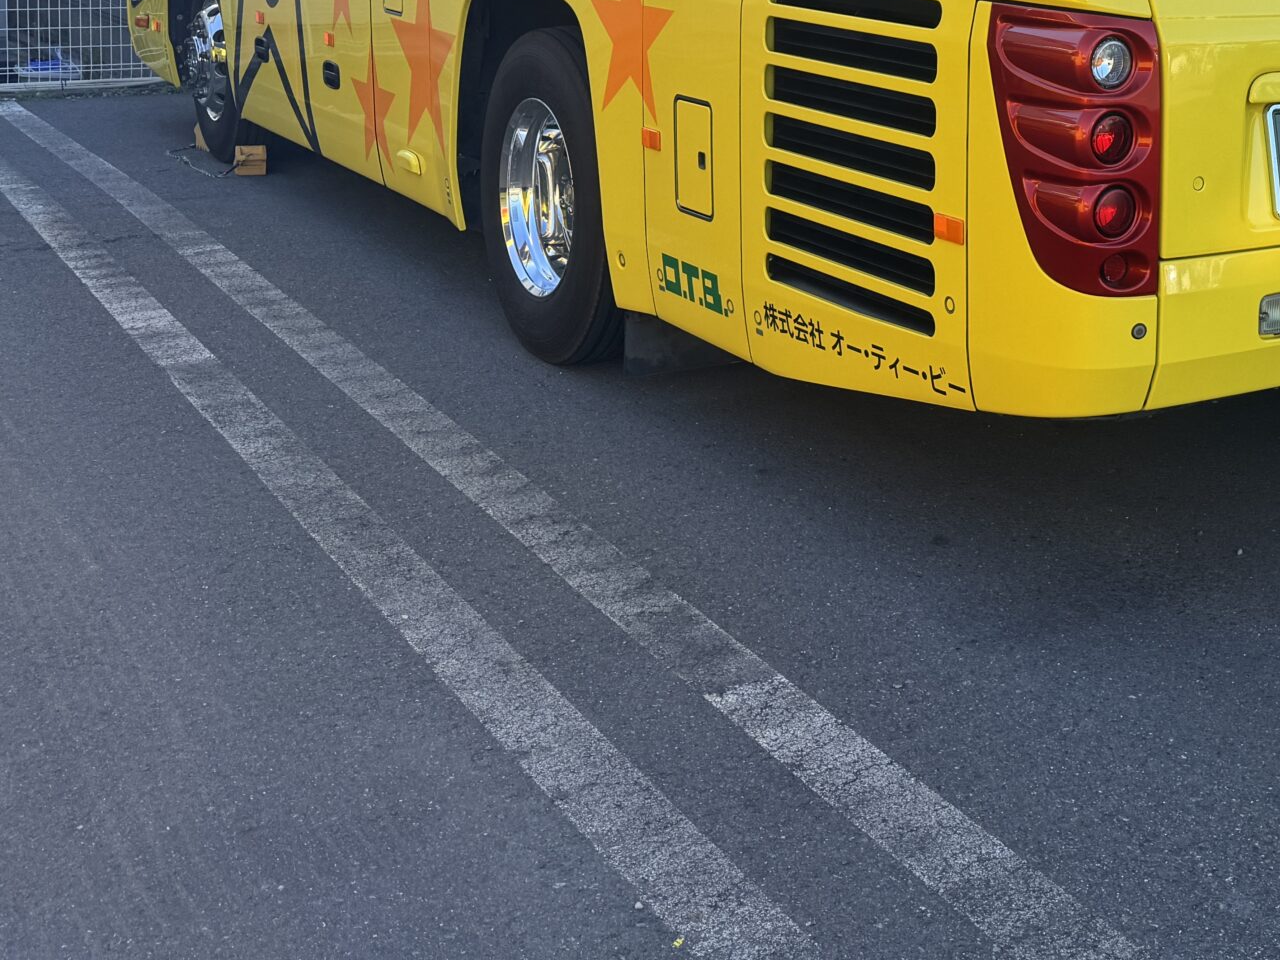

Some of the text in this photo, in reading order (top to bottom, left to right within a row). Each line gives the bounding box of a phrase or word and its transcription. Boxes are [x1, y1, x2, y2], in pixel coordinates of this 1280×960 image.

[661, 252, 729, 318] O.T.B.
[763, 300, 826, 351] 株式会社
